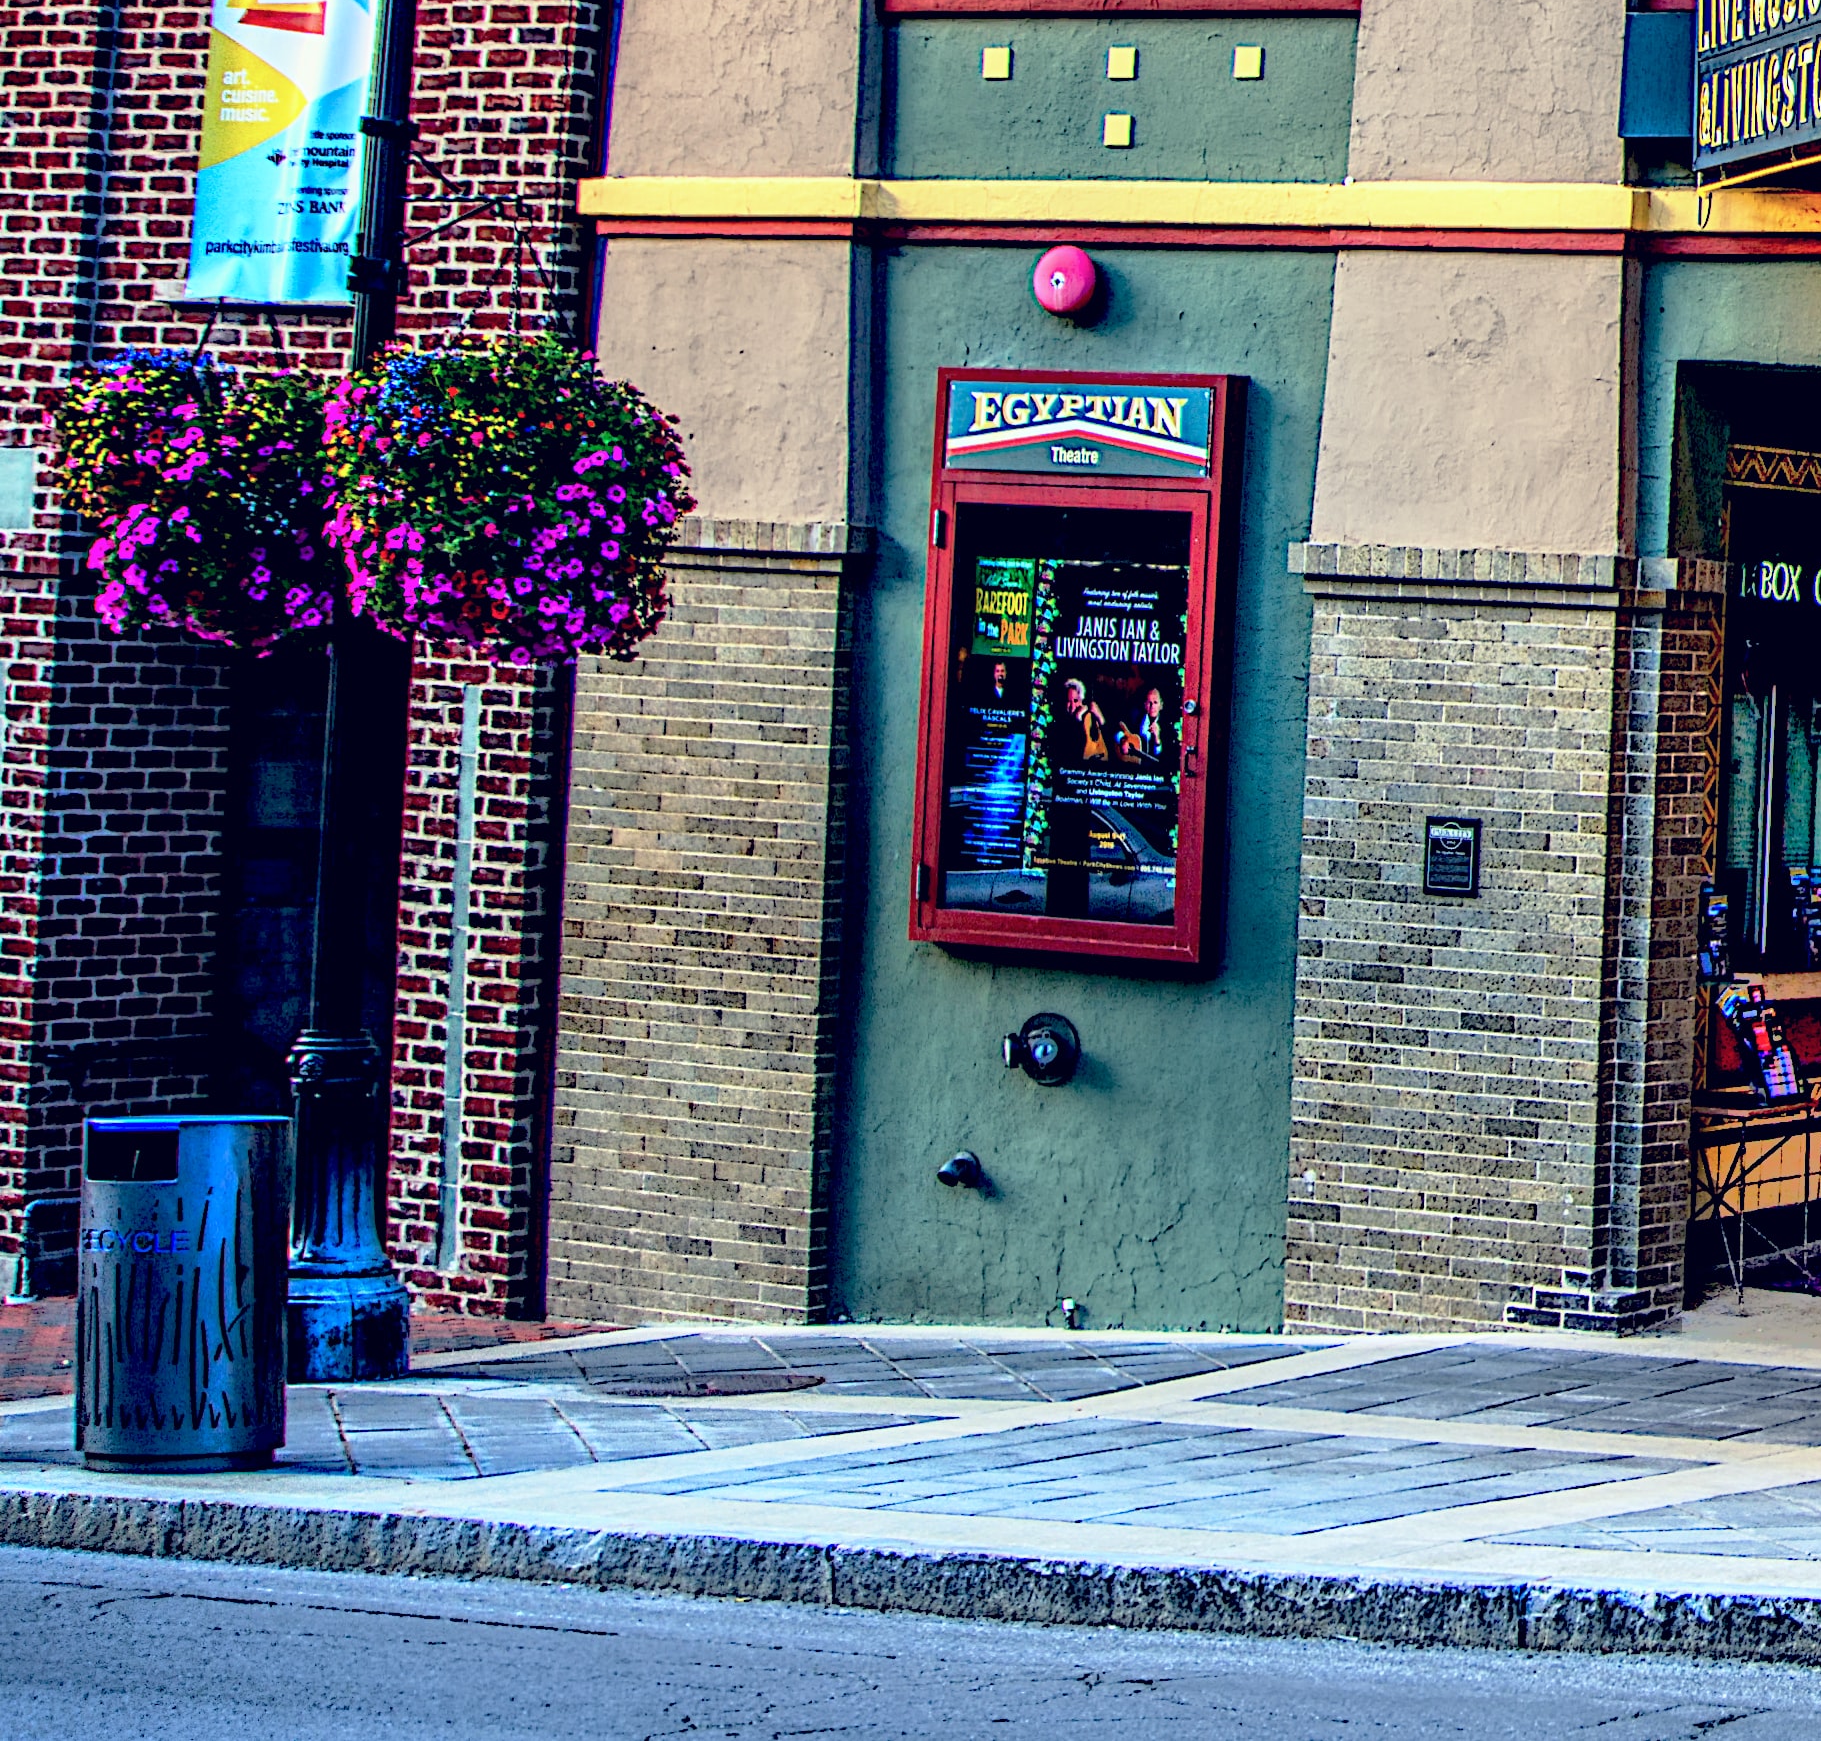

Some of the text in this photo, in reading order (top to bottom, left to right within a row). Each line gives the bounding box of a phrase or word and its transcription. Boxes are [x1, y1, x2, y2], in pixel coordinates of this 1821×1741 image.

[222, 68, 251, 85] art.
[221, 84, 279, 103] cuisine.
[219, 104, 270, 122] music.
[968, 390, 1189, 439] EGYPTIAN
[1051, 445, 1099, 465] Theatre
[1760, 560, 1802, 603] BOX
[975, 587, 1029, 616] BAREFOOT
[1000, 618, 1029, 646] PARK
[1075, 615, 1160, 641] JANIS IAN &
[1056, 635, 1181, 665] LIVINGSTON TAYLOR
